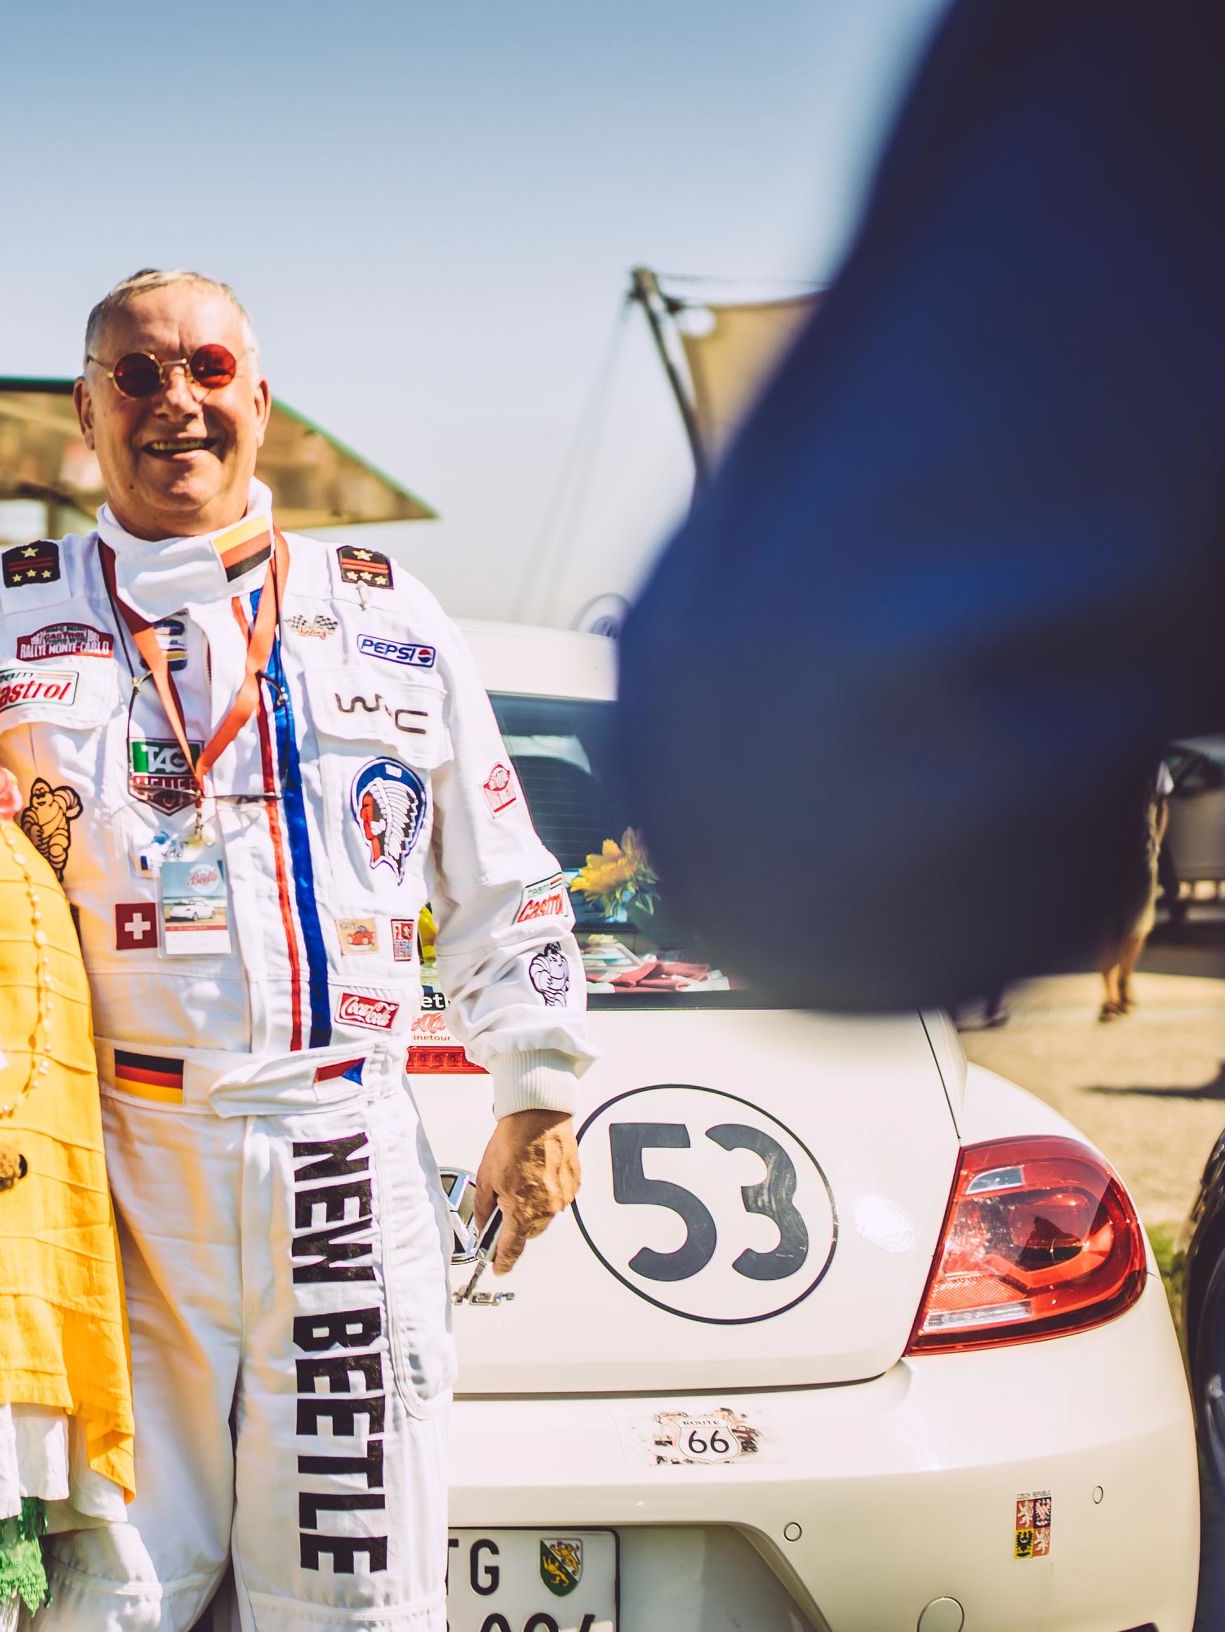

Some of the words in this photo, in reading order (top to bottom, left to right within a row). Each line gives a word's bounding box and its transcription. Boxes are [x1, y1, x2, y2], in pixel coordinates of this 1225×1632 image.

[20, 643, 46, 659] RALLYE
[361, 638, 416, 661] PEPSI
[141, 744, 193, 773] TAG
[340, 997, 399, 1026] Coca-Cola
[292, 1132, 377, 1284] NEW
[609, 1123, 809, 1282] 53
[293, 1306, 389, 1575] BEETLE
[688, 1430, 730, 1454] 66
